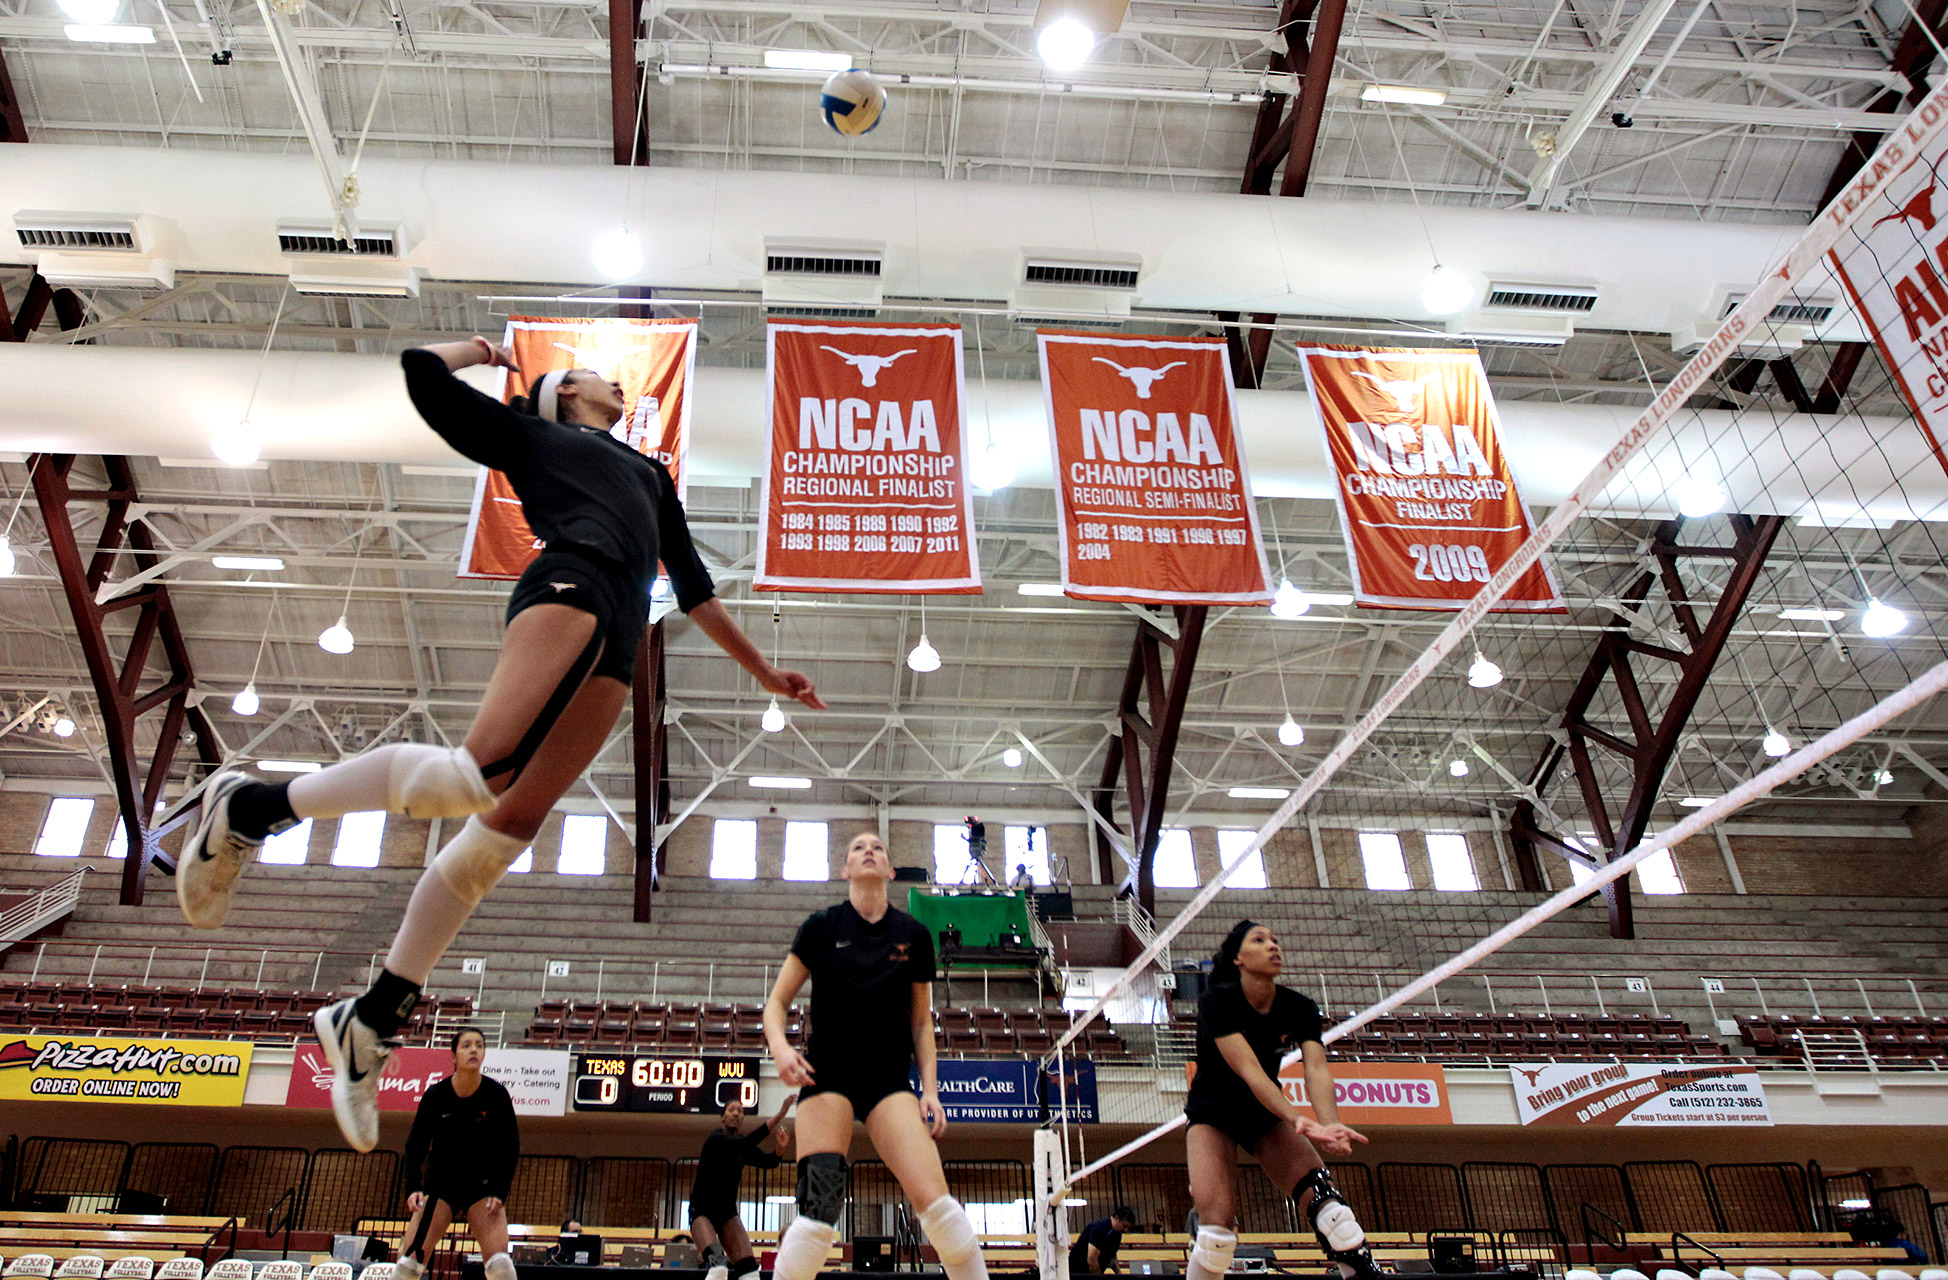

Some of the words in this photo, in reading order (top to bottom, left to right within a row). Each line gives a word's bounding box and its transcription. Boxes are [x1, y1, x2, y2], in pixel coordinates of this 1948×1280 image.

[1826, 142, 1904, 227] TEXAS
[1603, 415, 1651, 471] TEXAS
[1651, 314, 1745, 420] LONGHORNS
[799, 396, 942, 453] NCAA
[1079, 408, 1224, 465] NCAA
[1346, 421, 1494, 476] NCAA
[783, 451, 955, 478] CHAMPIONSHIP
[1070, 462, 1236, 490] CHAMPIONSHIP
[783, 476, 874, 497] REGIONAL
[878, 478, 956, 498] FINALIST
[1346, 473, 1507, 501] CHAMPIONSHIP
[1073, 487, 1143, 508] REGIONAL
[1144, 491, 1241, 511] SEMI-FINALIST
[1396, 501, 1473, 521] FINALIST
[781, 512, 814, 530] 1984
[818, 513, 850, 532] 1985
[854, 514, 887, 532] 1989
[890, 514, 923, 533] 1990
[926, 514, 958, 534] 1992
[1077, 522, 1109, 540] 1982
[1112, 524, 1144, 542] 1983
[1146, 527, 1178, 544] 1991
[1182, 527, 1213, 545] 1996
[1216, 529, 1247, 545] 1997
[780, 532, 813, 550] 1993
[817, 533, 850, 551] 1998
[854, 534, 887, 552] 2006
[890, 535, 923, 553] 2007
[926, 535, 960, 554] 2011
[1077, 543, 1111, 560] 2004
[1408, 543, 1492, 583] 2009
[1456, 590, 1489, 631] TEXAS
[1488, 523, 1552, 597] LONGHORNS
[467, 964, 477, 972] 41
[553, 967, 564, 975] 42
[1076, 978, 1086, 986] 42
[483, 1066, 502, 1074] Dine
[520, 1067, 539, 1075] Take
[586, 1059, 626, 1075] TEXAS
[634, 1060, 703, 1086] 60:00
[719, 1062, 744, 1078] WVU
[1661, 1069, 1689, 1079] Order
[1691, 1069, 1722, 1079] online
[1723, 1070, 1734, 1079] at
[32, 1078, 79, 1094] ORDER
[83, 1080, 136, 1097] ONLINE
[138, 1081, 181, 1098] NOW!
[523, 1080, 560, 1091] Catering
[600, 1077, 616, 1103] 0
[740, 1080, 756, 1106] 0
[1334, 1082, 1431, 1104] DONUTS
[1527, 1085, 1565, 1111] Bring
[1562, 1074, 1592, 1097] your
[1591, 1064, 1629, 1086] group
[1665, 1082, 1748, 1093] TexasSports.com
[648, 1092, 674, 1102] PERIOD
[680, 1089, 686, 1106] 1
[1576, 1110, 1590, 1123] to
[1587, 1100, 1607, 1117] the
[1603, 1091, 1629, 1108] next
[1627, 1078, 1660, 1101] game!
[1669, 1097, 1690, 1107] Call
[1691, 1097, 1715, 1108] (512)
[1717, 1097, 1763, 1108] 232-3865
[962, 1108, 1010, 1119] PROVIDER
[1013, 1108, 1024, 1118] OF
[1027, 1109, 1039, 1119] UT
[1631, 1113, 1655, 1122] Group
[1656, 1112, 1685, 1121] Tickets
[1686, 1113, 1705, 1121] start
[1715, 1113, 1726, 1122] $3
[13, 1266, 46, 1274] VOLLEYBALL
[16, 1257, 52, 1267] TEXAS
[66, 1259, 102, 1268] TEXAS
[117, 1260, 152, 1269] TEXAS
[167, 1261, 202, 1270] TEXAS
[216, 1262, 251, 1272] TEXAS
[266, 1264, 301, 1274] TEXAS
[316, 1266, 350, 1275] TEXAS
[366, 1267, 393, 1275] TEXA
